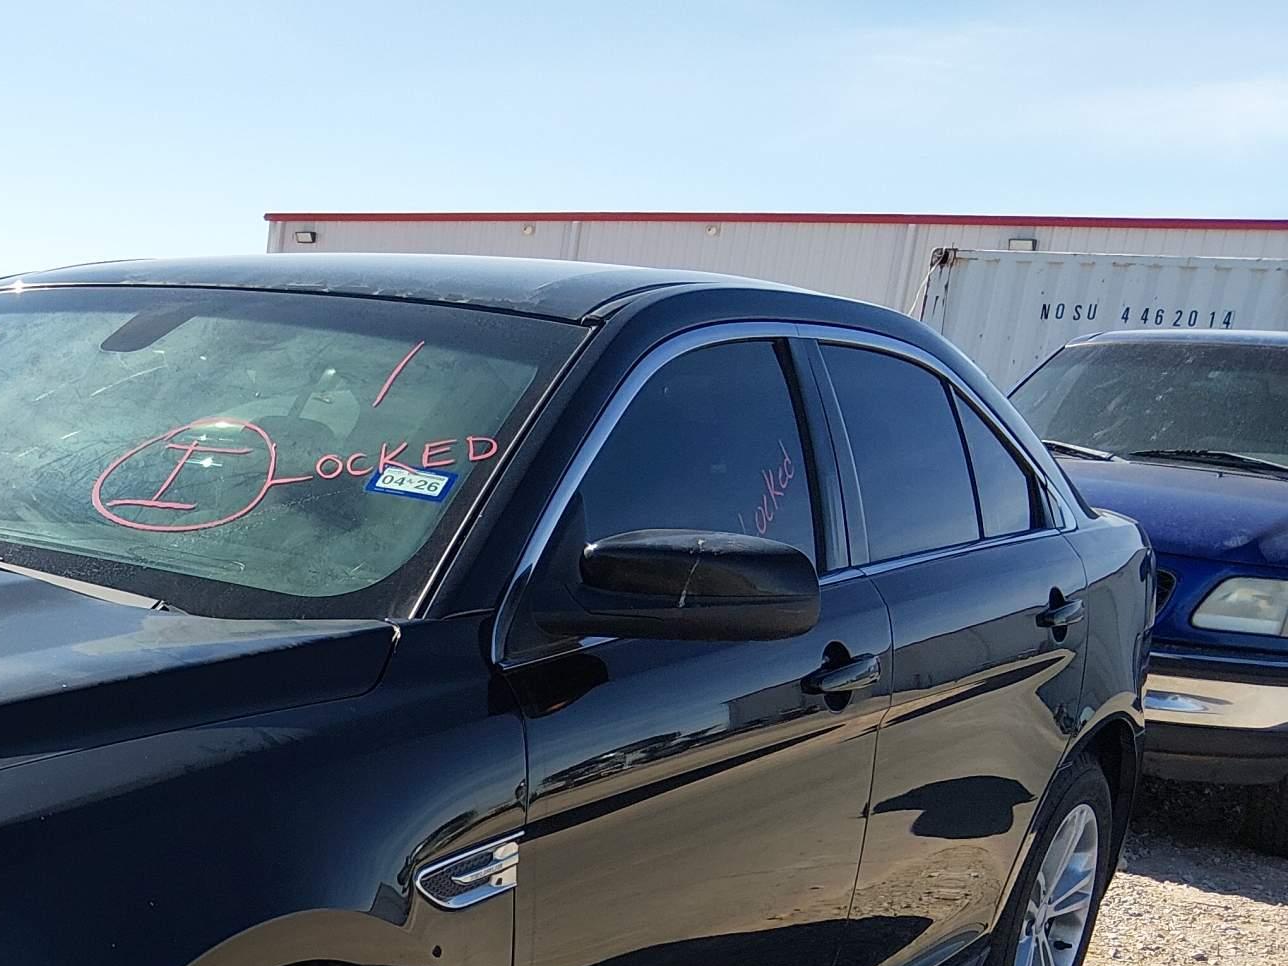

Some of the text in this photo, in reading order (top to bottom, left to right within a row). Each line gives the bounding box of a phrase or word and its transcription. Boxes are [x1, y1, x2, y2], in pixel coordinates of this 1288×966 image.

[1040, 303, 1234, 329] NOSU 4462014
[267, 436, 498, 486] LOCKED
[381, 474, 405, 487] 04
[414, 479, 441, 492] 26
